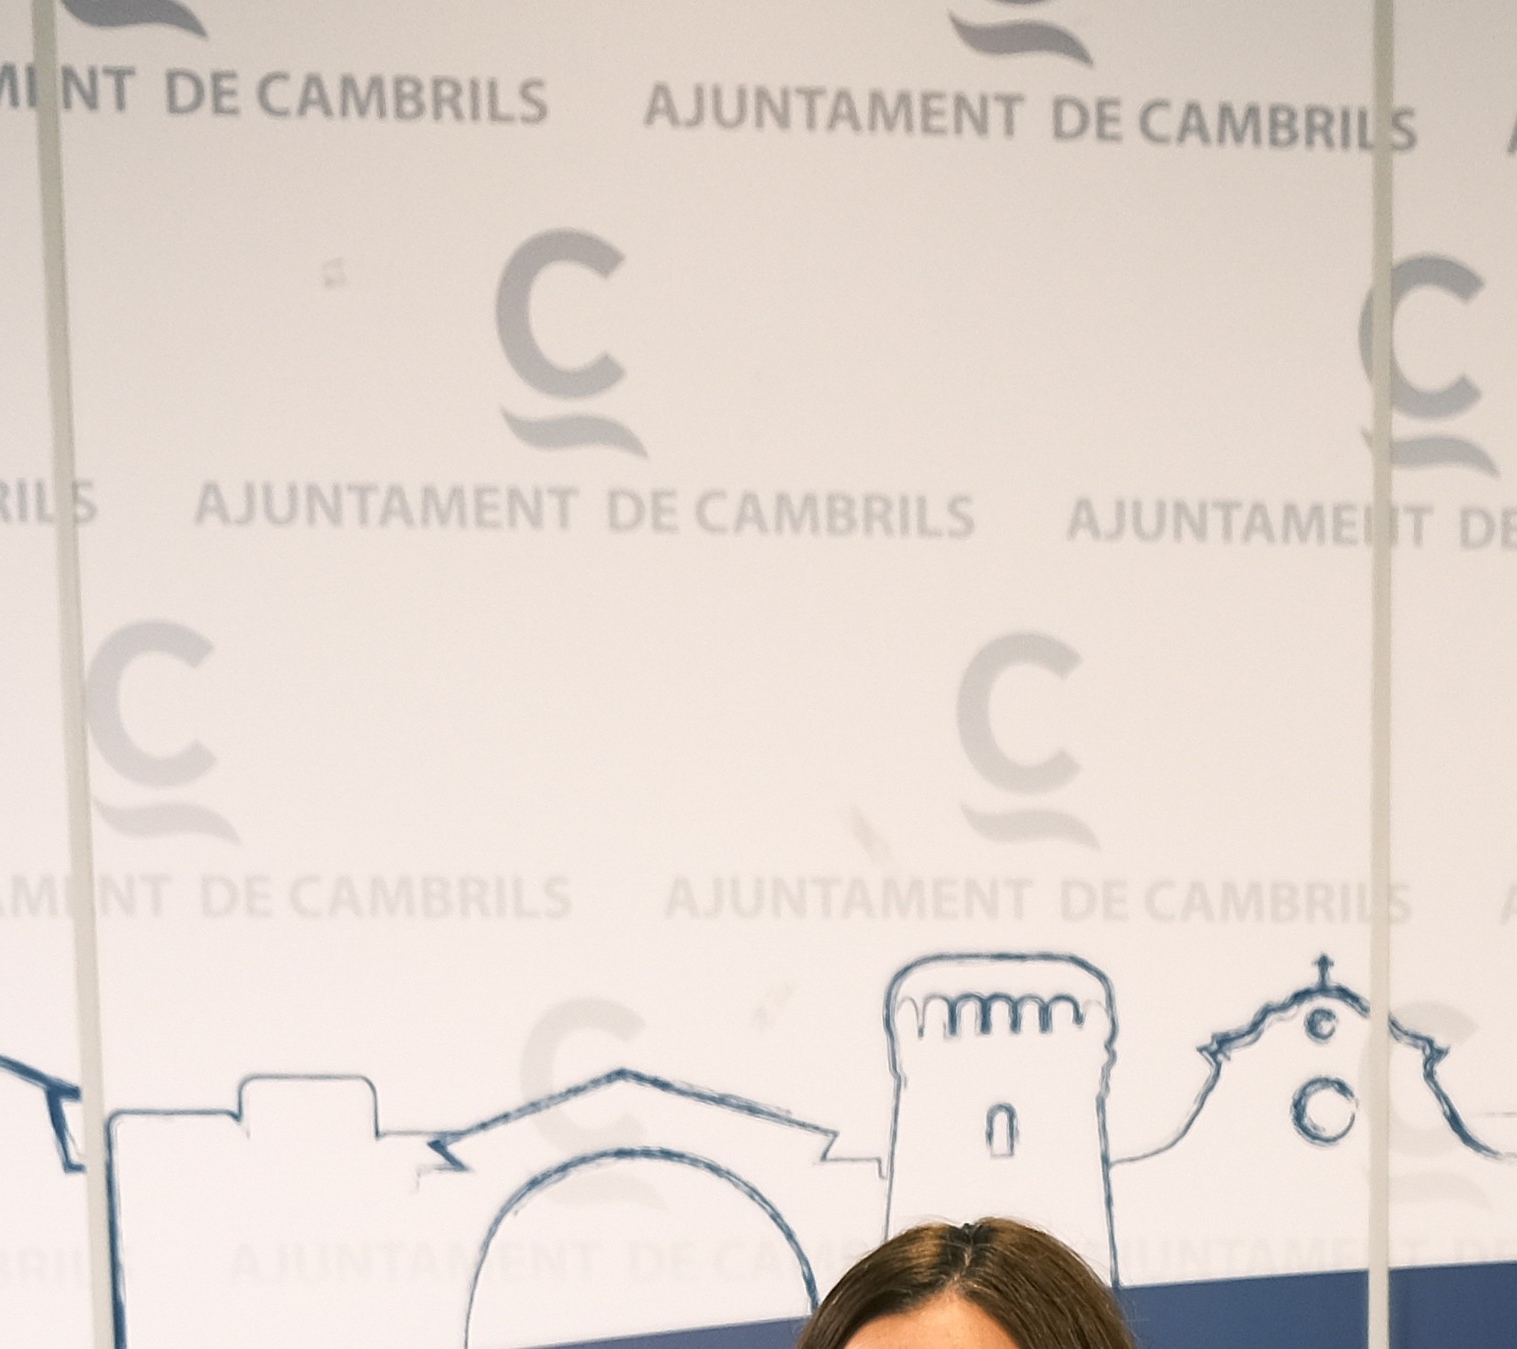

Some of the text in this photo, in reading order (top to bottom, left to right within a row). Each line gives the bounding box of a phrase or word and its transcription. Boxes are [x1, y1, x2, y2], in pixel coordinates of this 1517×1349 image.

[165, 70, 242, 119] DE
[256, 71, 549, 126] CAMBRILS
[643, 81, 1418, 156] AJUNTAMENT DE CAMBRILS
[194, 479, 975, 542] AJUNTAMENT DE CAMBRILS
[199, 874, 274, 920] DE
[288, 874, 574, 922] CAMBRILS
[663, 876, 1033, 923] AJUNTAMENT
[1058, 879, 1131, 924] DE
